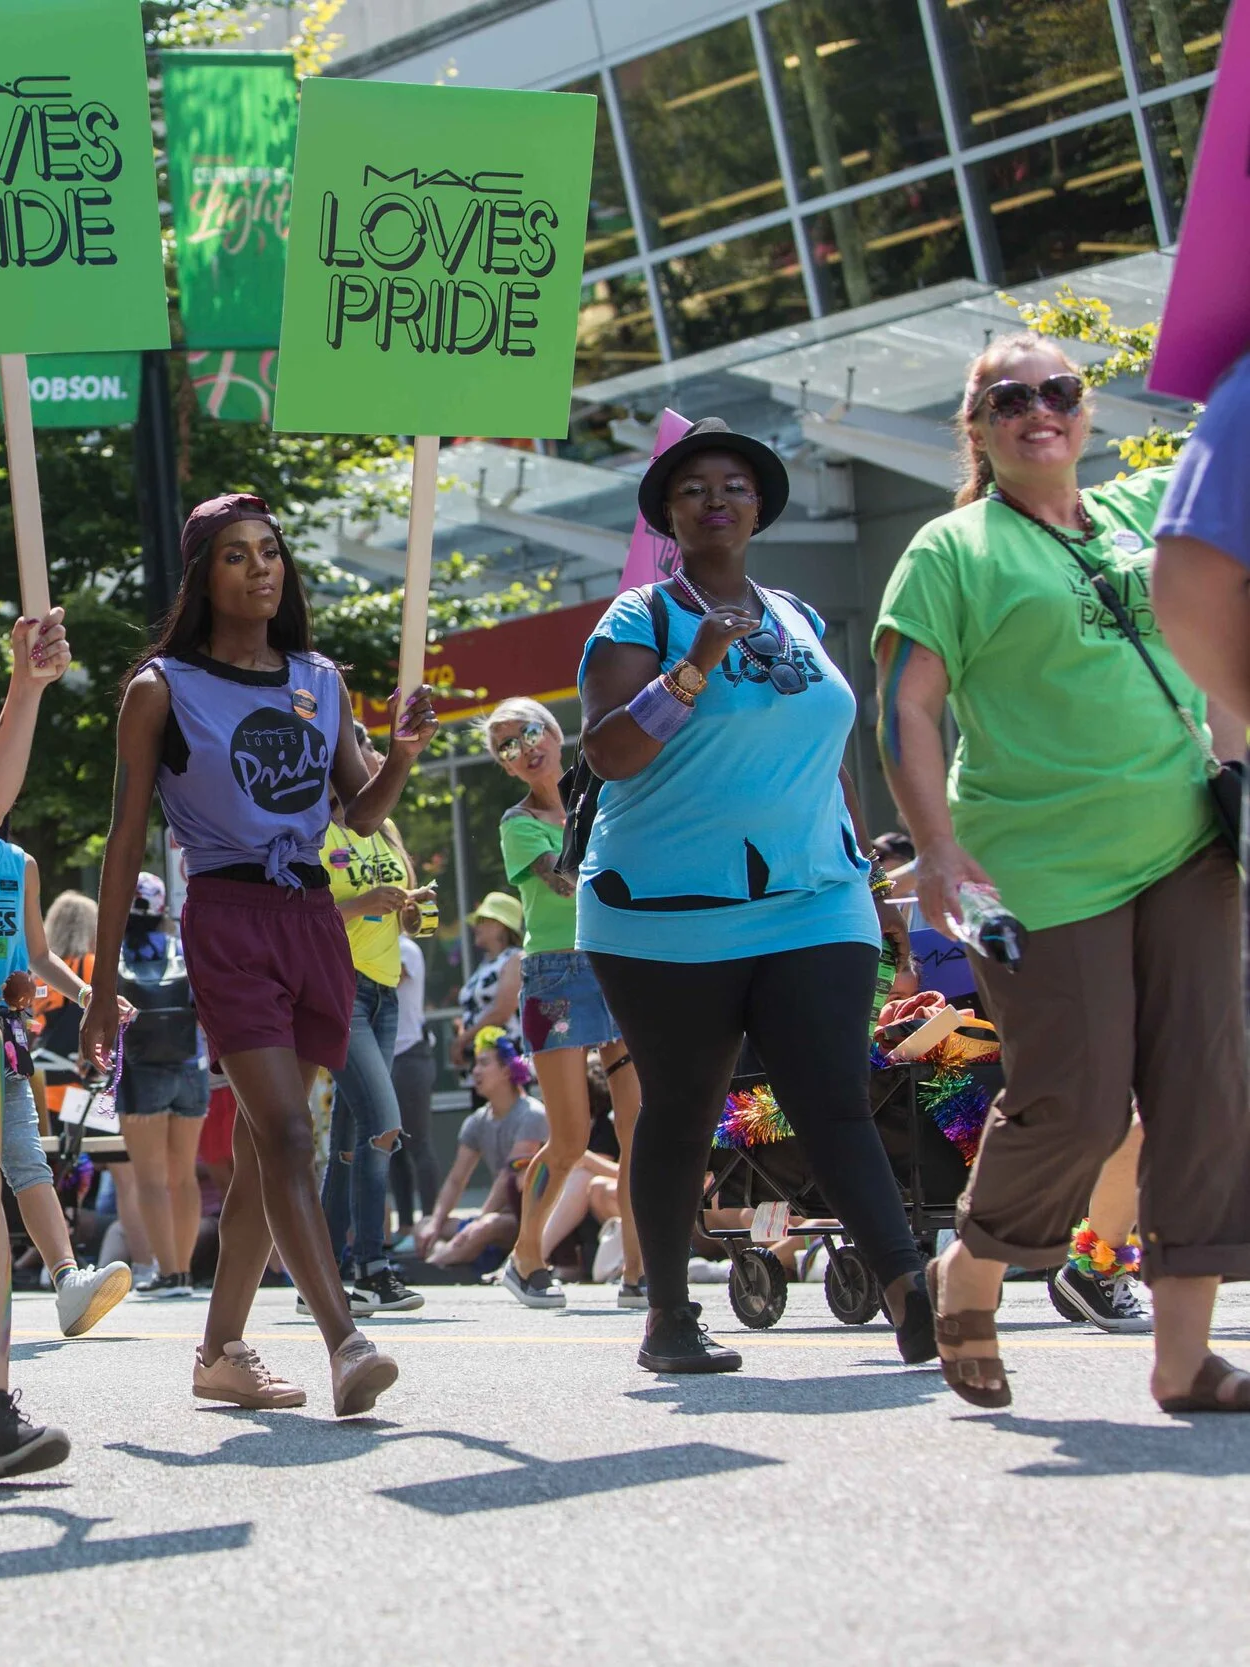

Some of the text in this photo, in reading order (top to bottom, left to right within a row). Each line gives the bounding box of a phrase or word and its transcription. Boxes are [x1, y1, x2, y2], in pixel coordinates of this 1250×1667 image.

[319, 191, 558, 277] LOVES
[326, 274, 539, 356] PRIDE
[29, 376, 128, 401] OBSON.
[234, 730, 328, 800] Pride
[245, 734, 297, 747] LOVES
